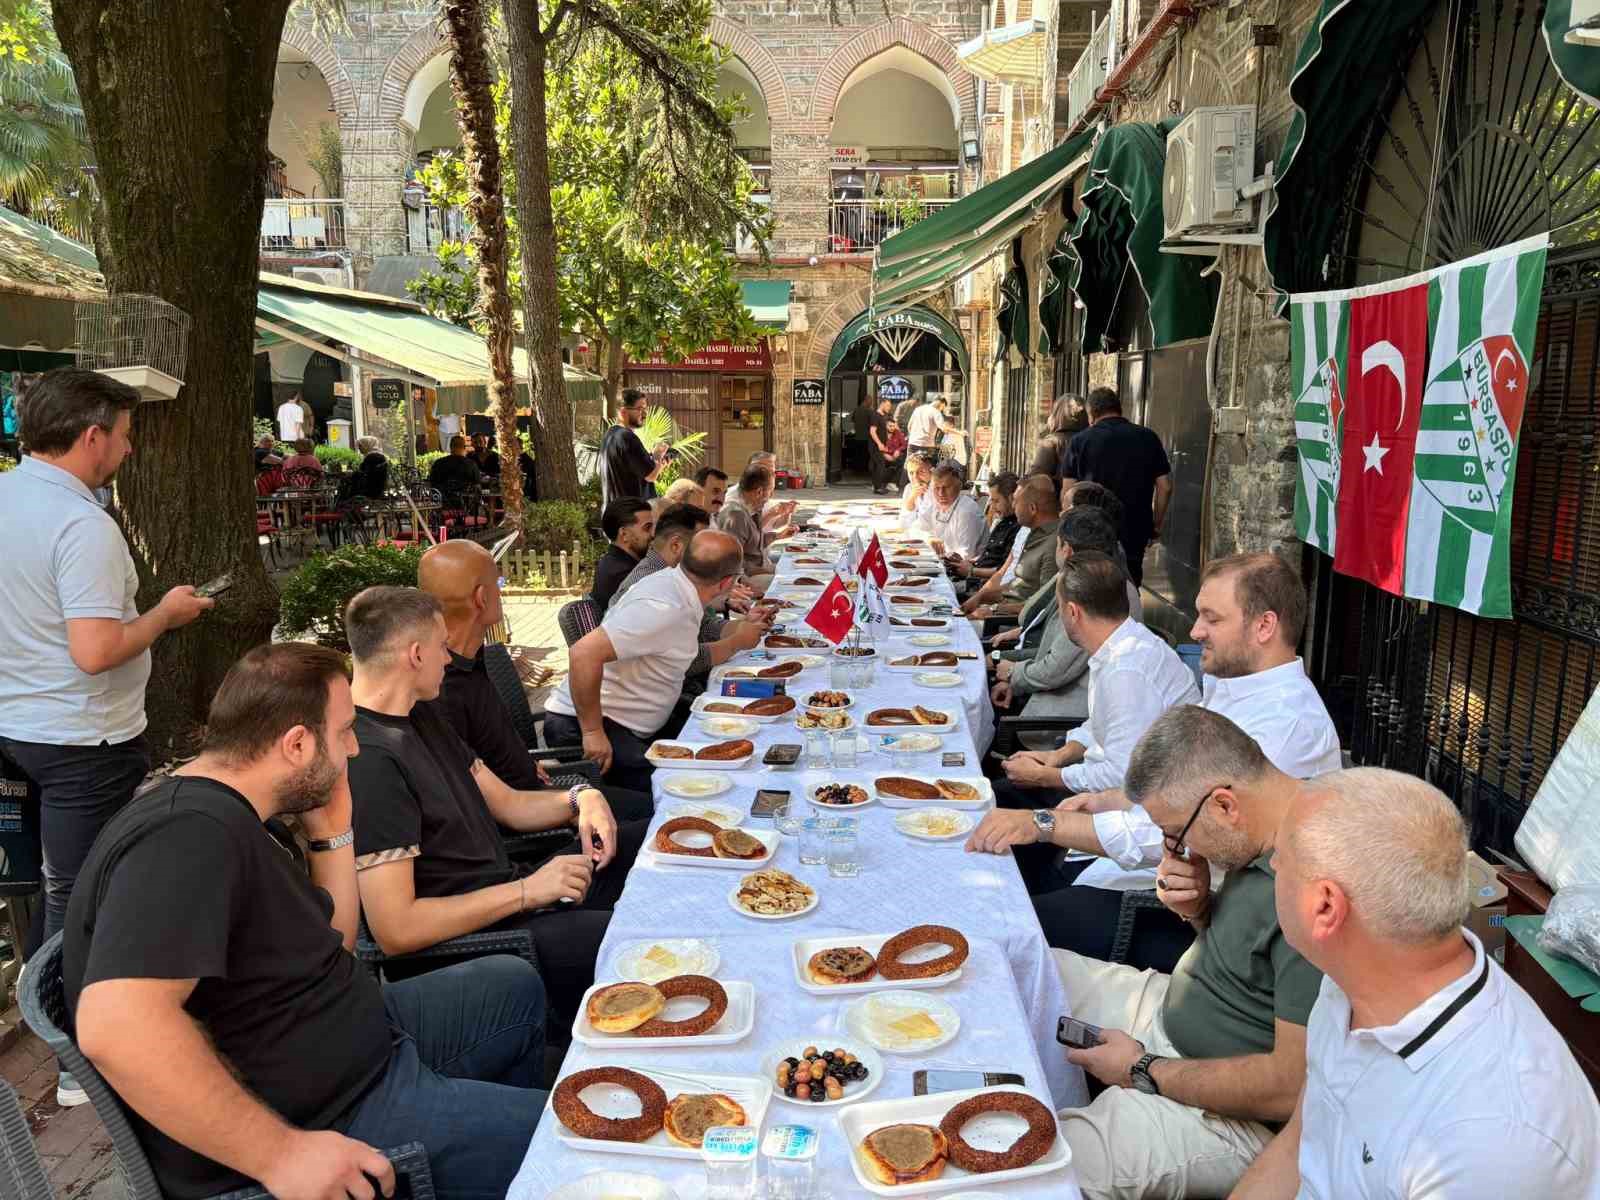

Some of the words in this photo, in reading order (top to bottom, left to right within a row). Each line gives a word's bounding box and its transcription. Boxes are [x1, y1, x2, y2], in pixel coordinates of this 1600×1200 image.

[835, 148, 856, 156] SERA
[878, 313, 913, 328] FABA
[794, 389, 823, 398] FABA
[881, 384, 909, 394] FABA
[1453, 410, 1484, 503] 1963
